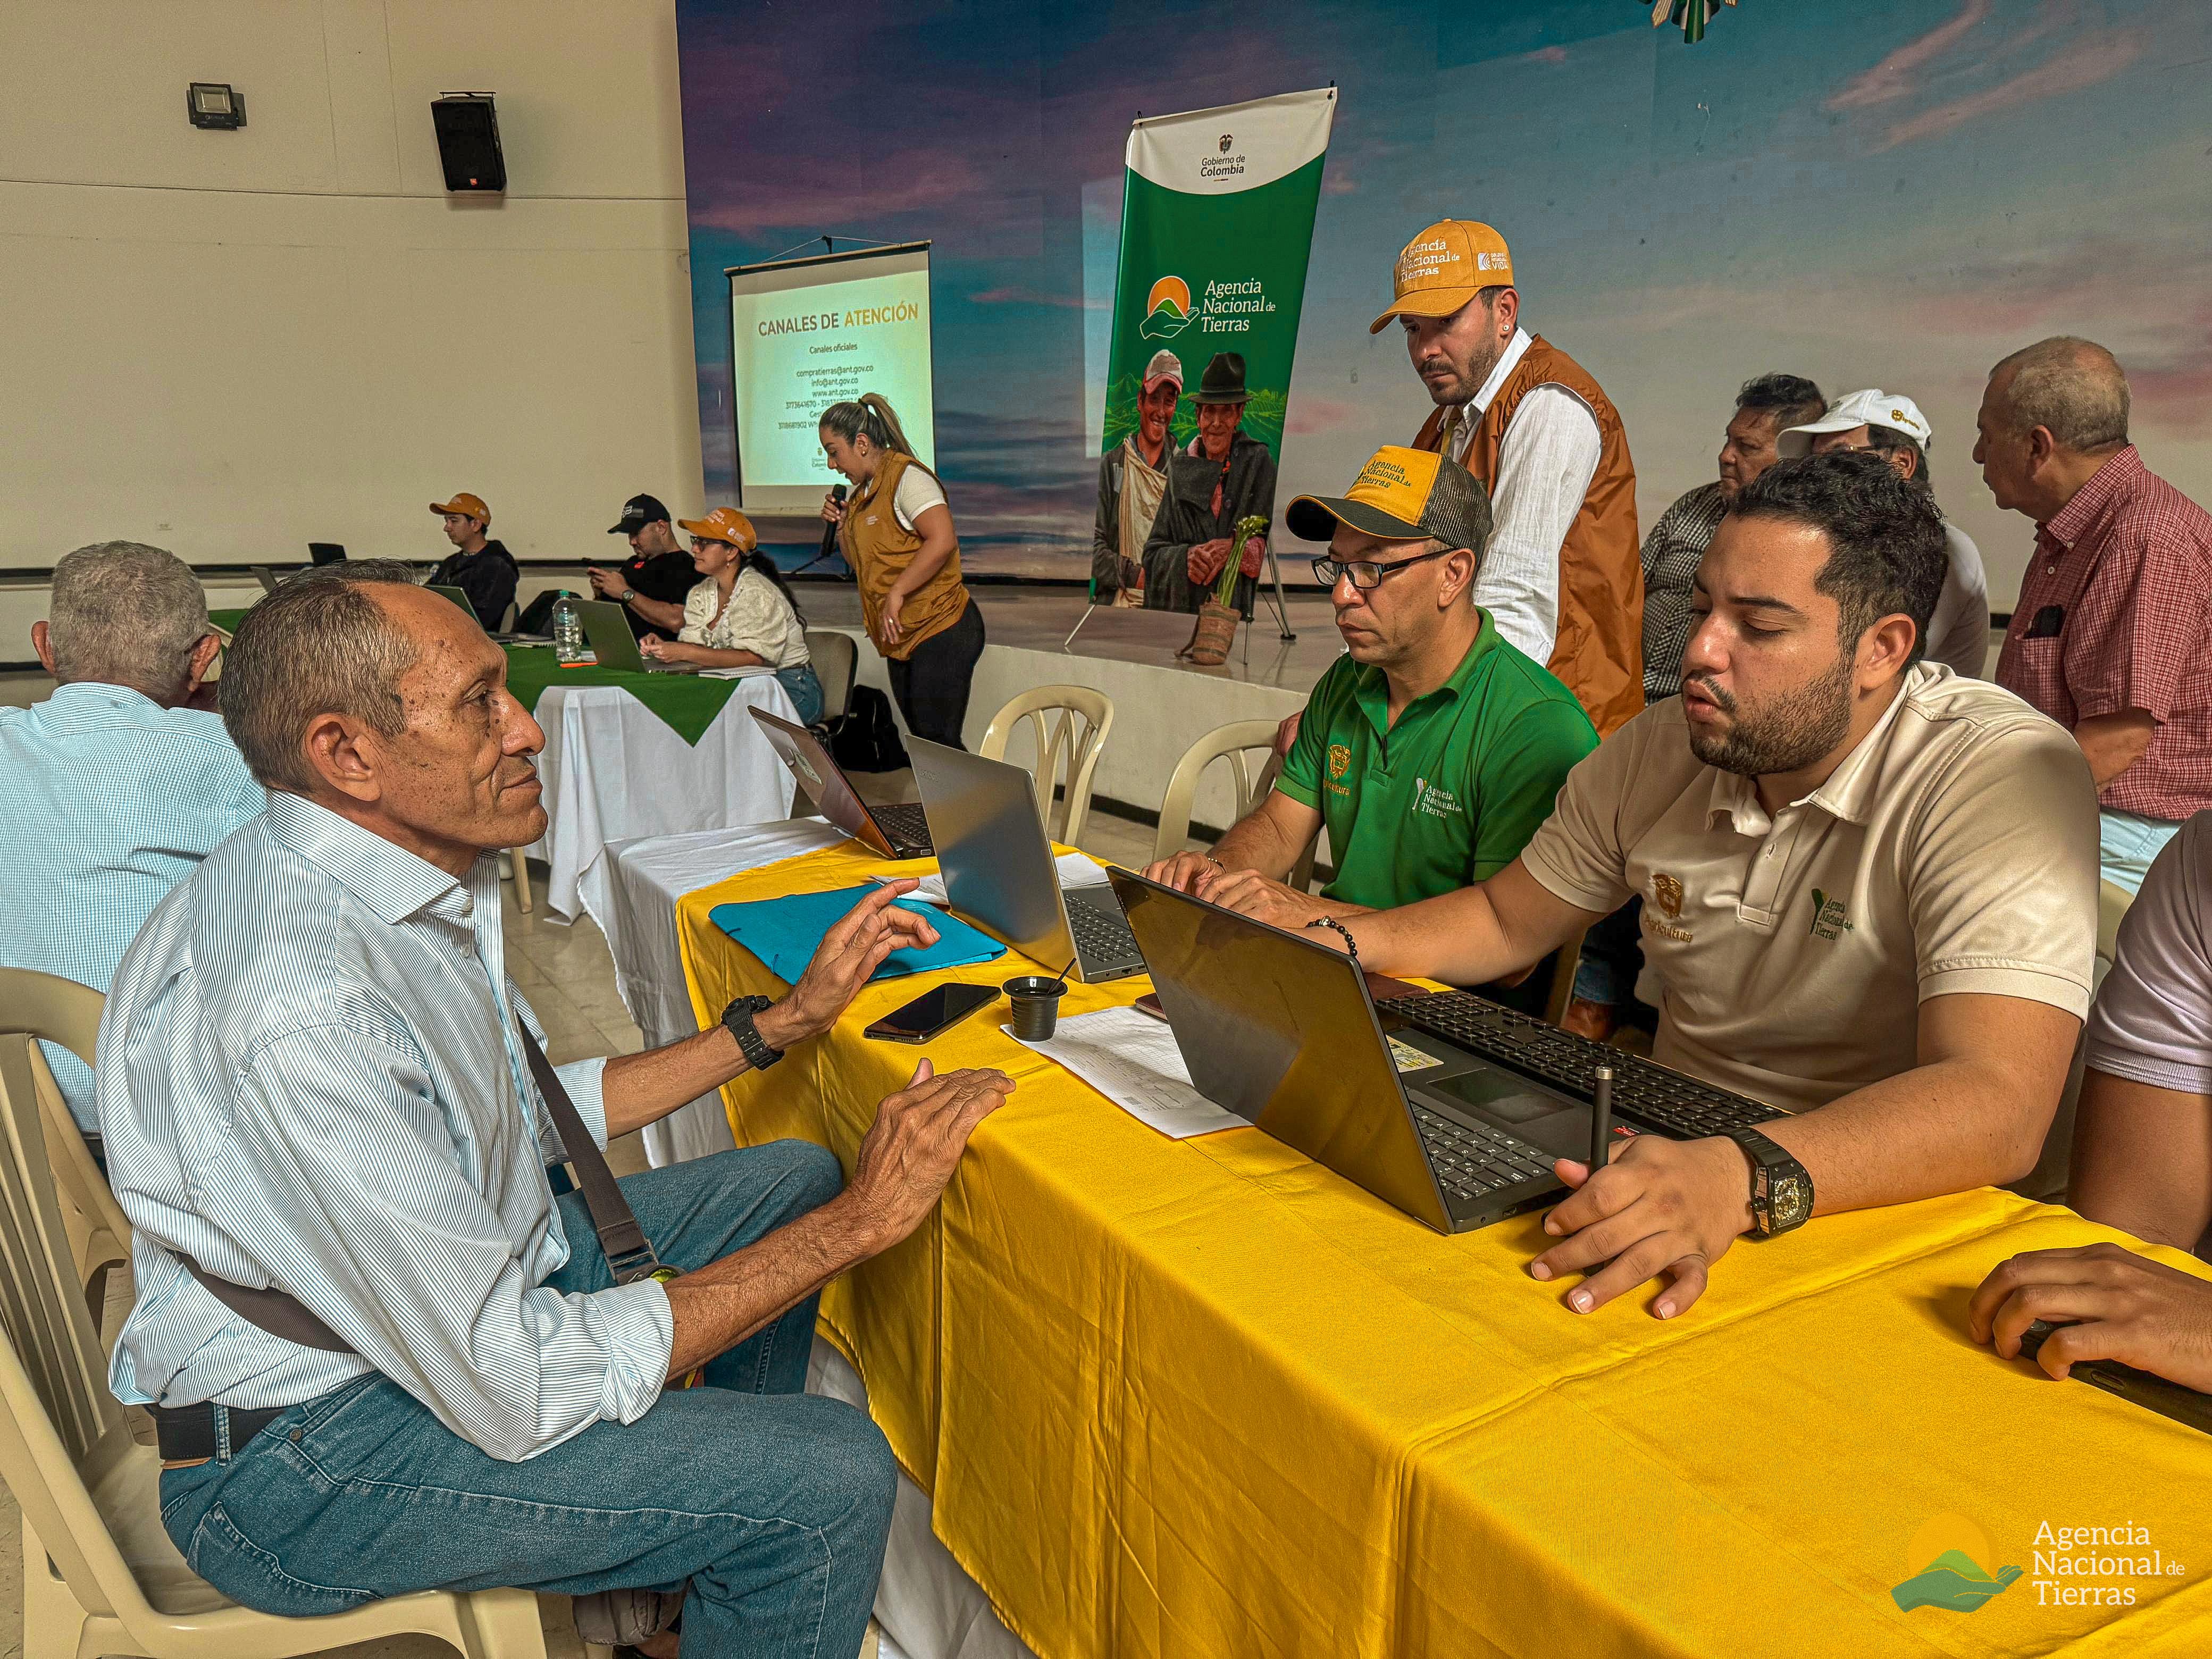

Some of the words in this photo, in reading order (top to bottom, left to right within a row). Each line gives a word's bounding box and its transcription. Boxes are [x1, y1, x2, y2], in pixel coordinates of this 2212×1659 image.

[1202, 156, 1234, 166] Gobierno
[1236, 155, 1245, 163] de
[1201, 164, 1244, 177] Colombia
[1205, 278, 1261, 298] Agencia
[1203, 296, 1264, 314] Nacional
[1266, 303, 1276, 312] de
[759, 315, 817, 336] CANALES
[821, 313, 839, 330] DE
[844, 301, 918, 327] ATENCIÓN
[1202, 316, 1249, 332] Tierras
[809, 345, 832, 354] Canales
[833, 343, 858, 351] oficiales
[812, 378, 858, 387] info@ant.gov.co
[812, 389, 859, 397] www.ant.gov.co
[1364, 468, 1405, 483] Nacional
